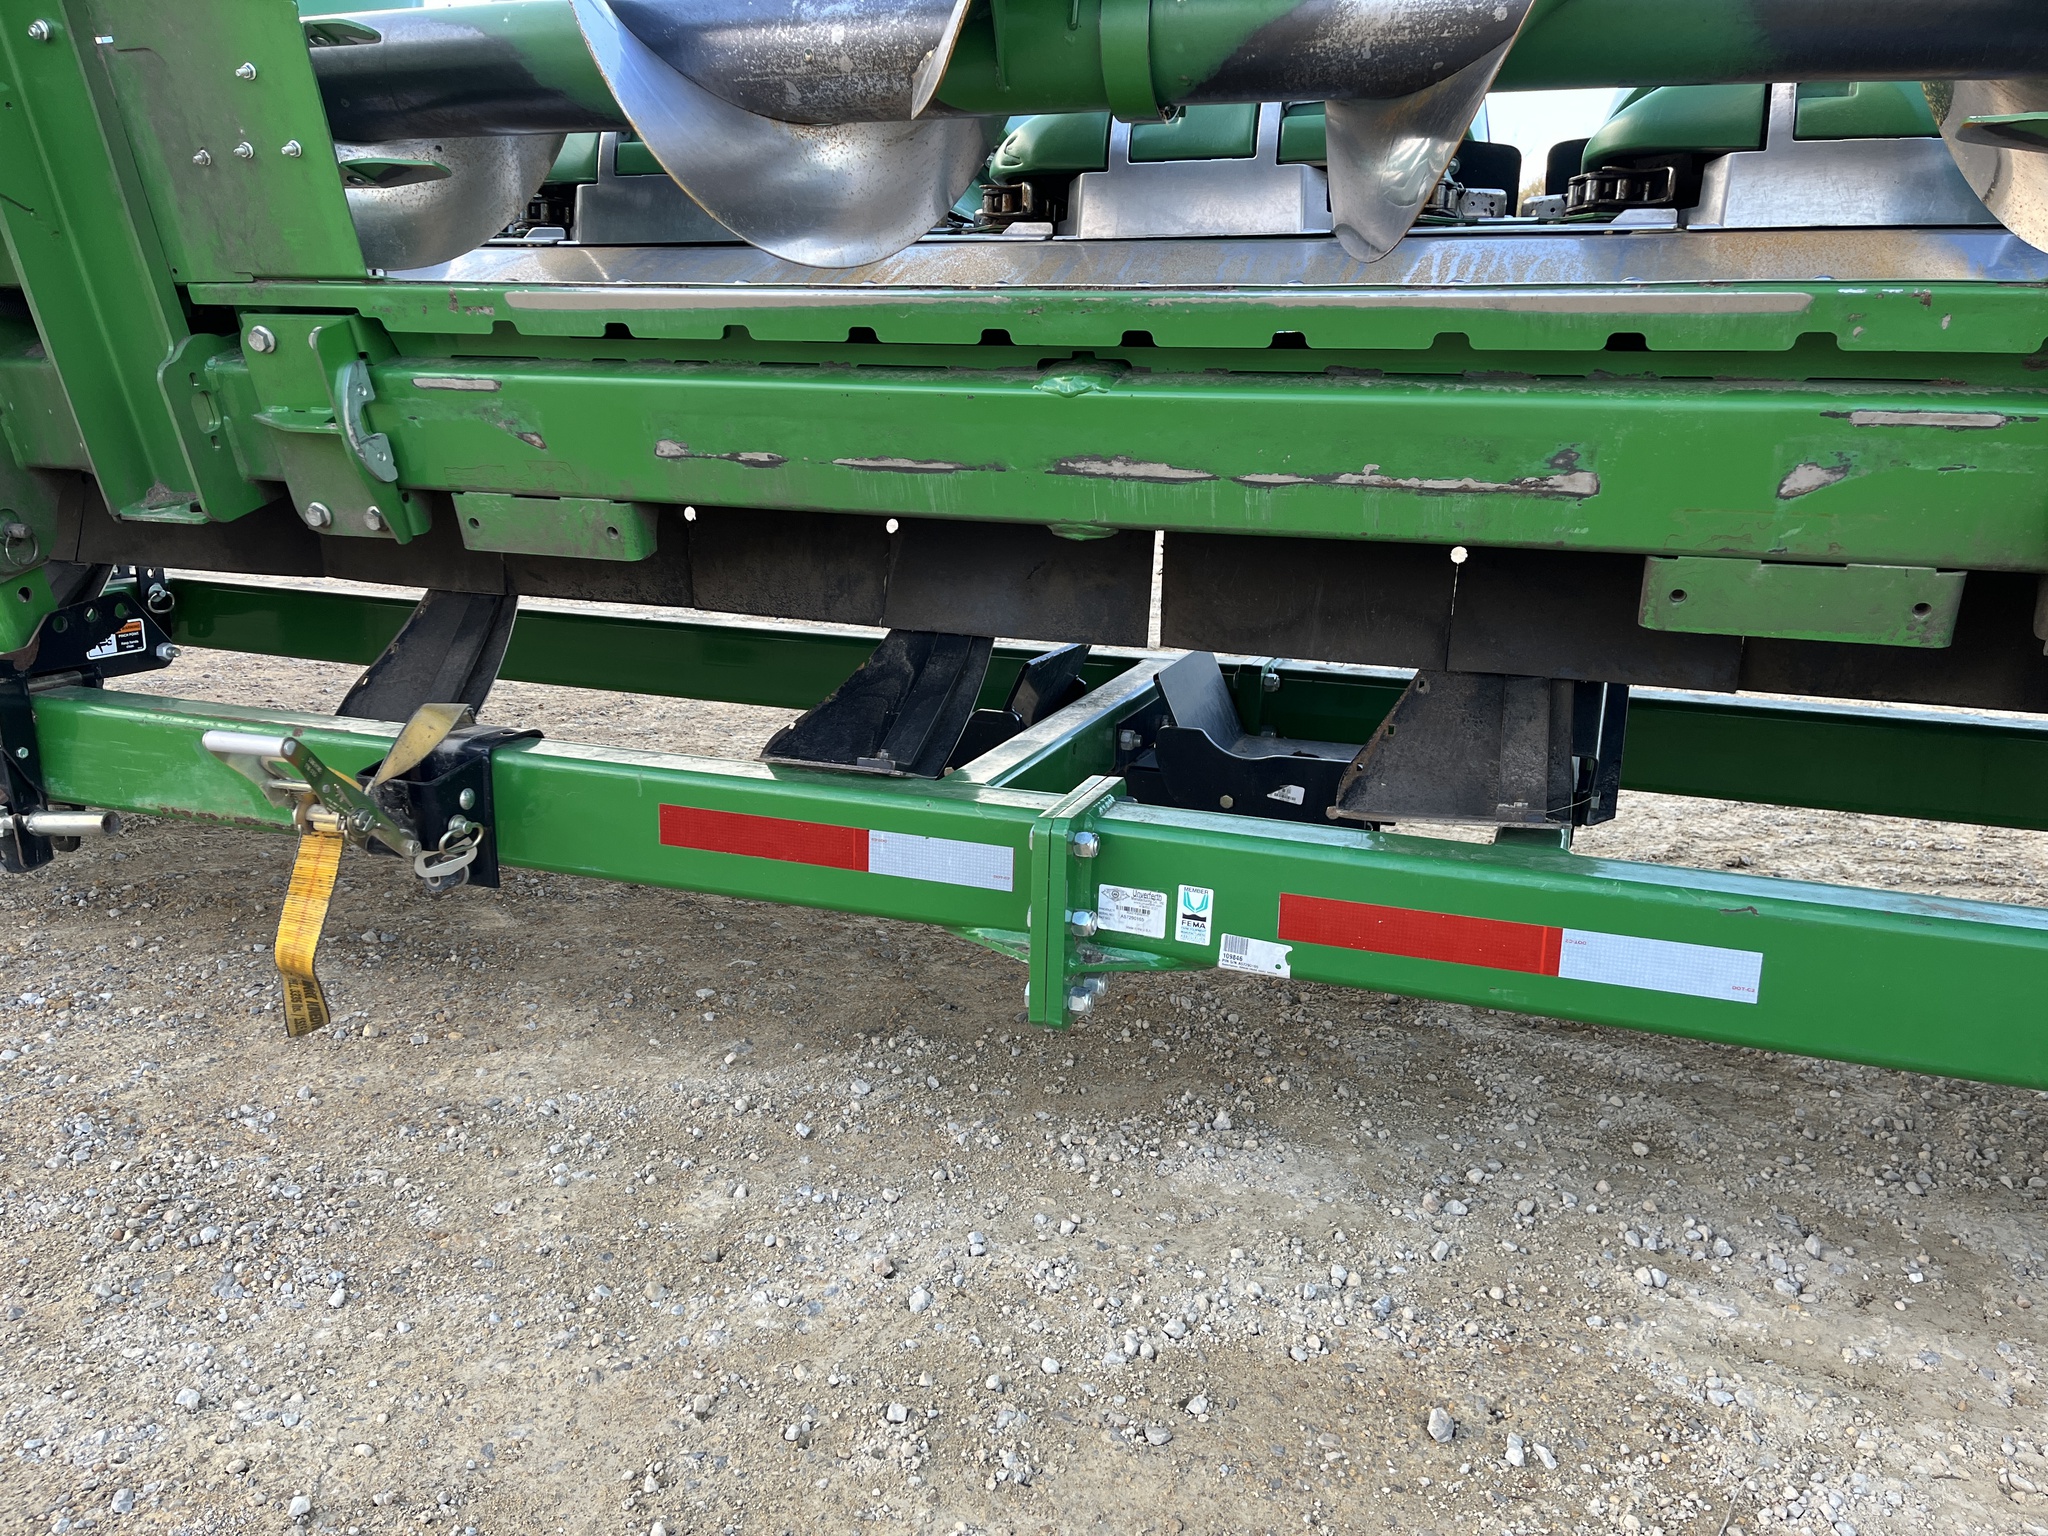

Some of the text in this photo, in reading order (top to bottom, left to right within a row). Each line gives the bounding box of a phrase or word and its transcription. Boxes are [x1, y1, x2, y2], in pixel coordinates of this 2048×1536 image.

[1184, 886, 1208, 895] MEMBER
[1181, 920, 1206, 929] FEMA
[1731, 985, 1755, 993] DOT-C2
